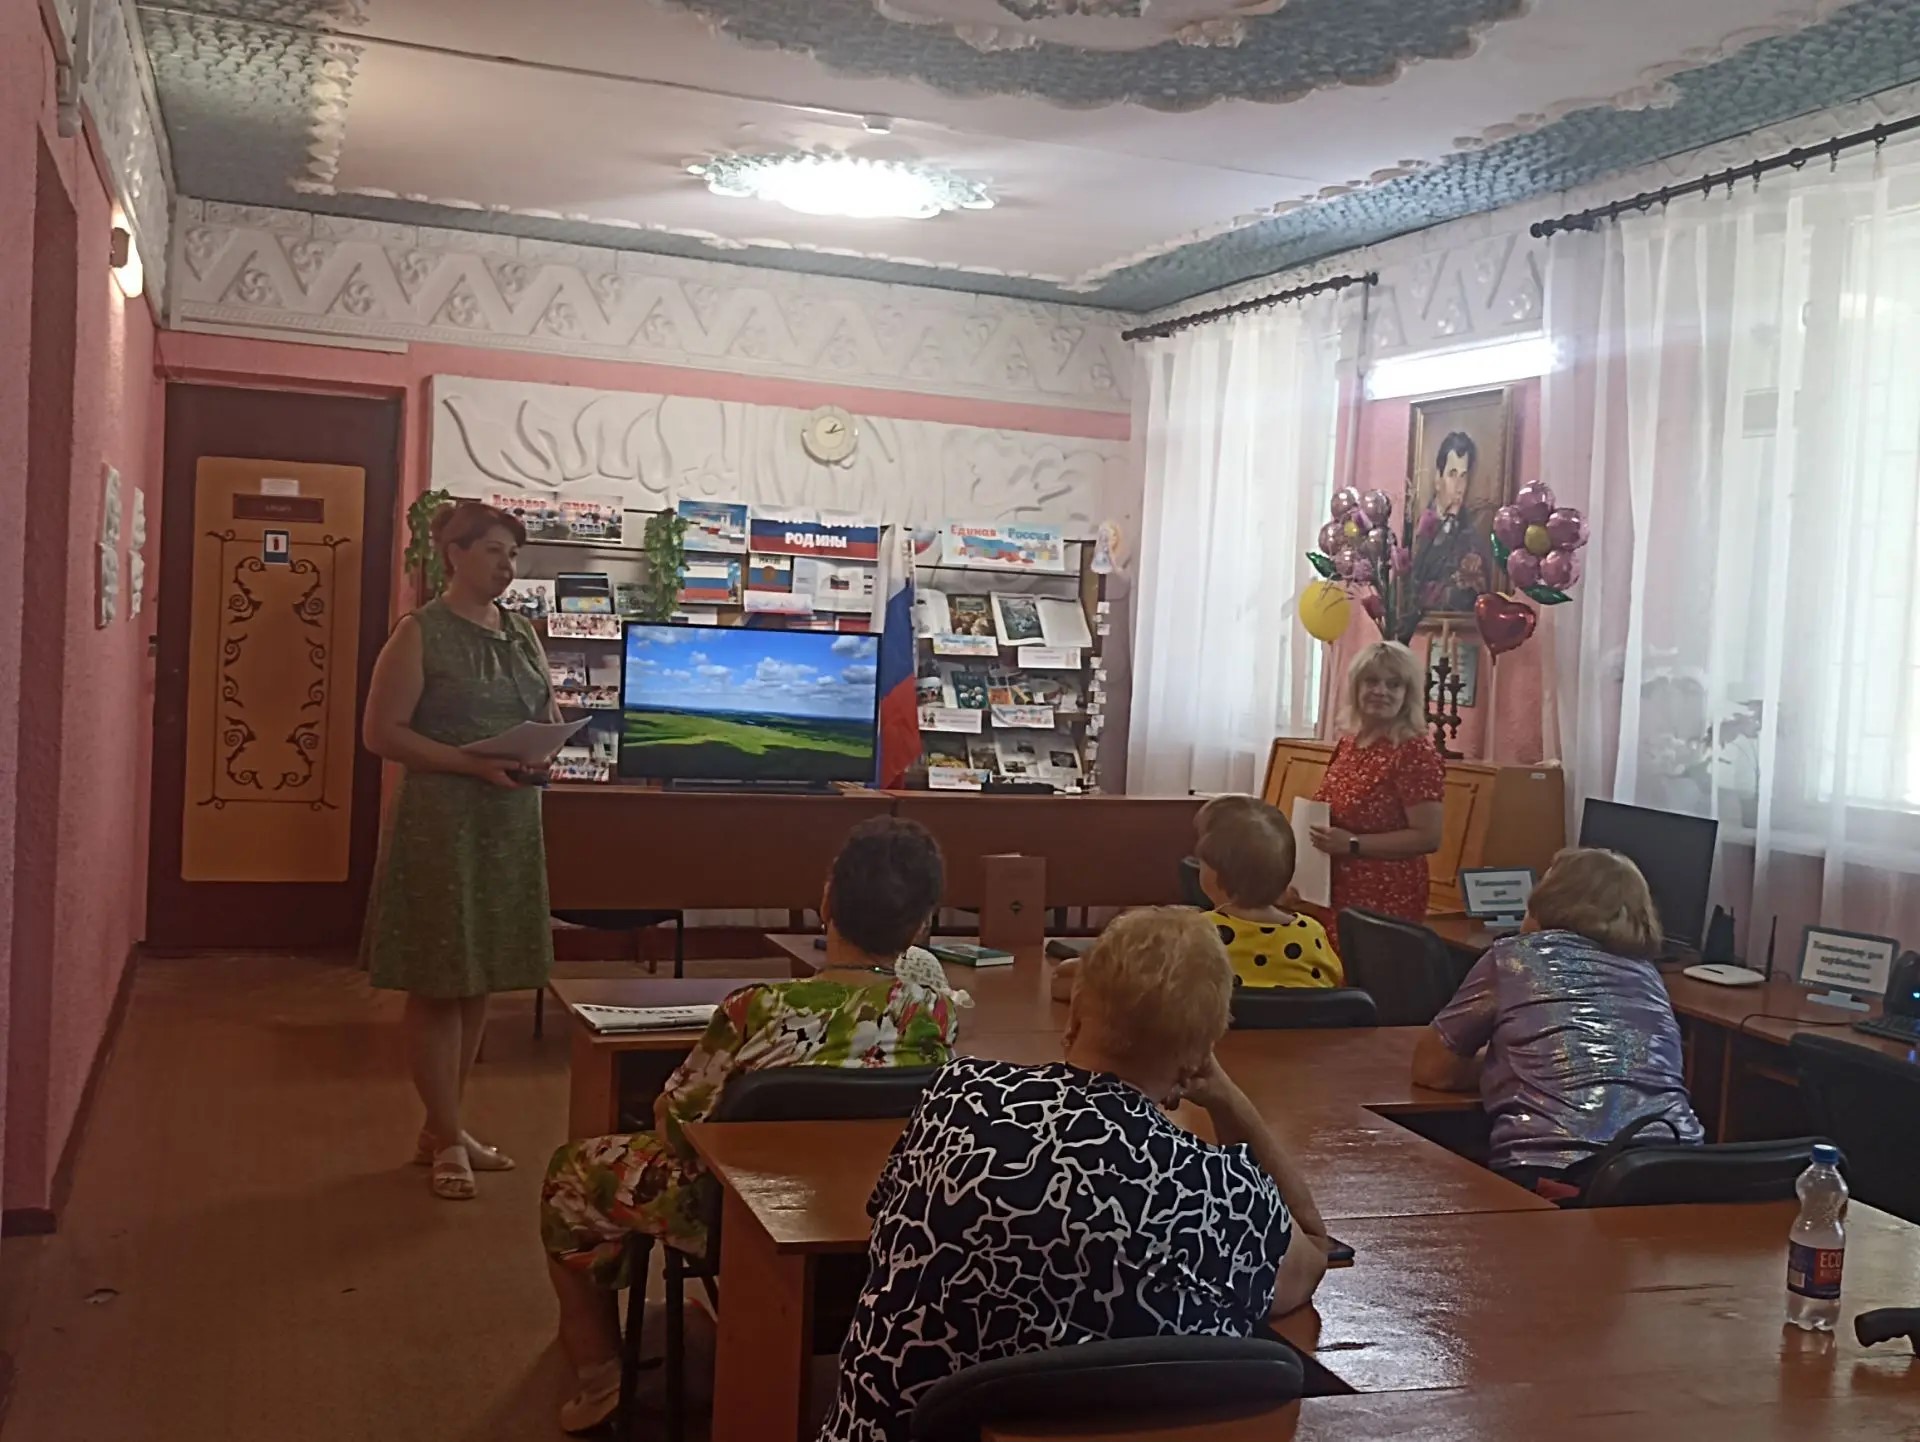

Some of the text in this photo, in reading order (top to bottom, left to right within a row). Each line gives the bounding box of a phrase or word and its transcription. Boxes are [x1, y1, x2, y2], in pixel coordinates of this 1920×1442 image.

[784, 531, 847, 549] РОДИНЫ
[950, 524, 1050, 541] Единая Россия
